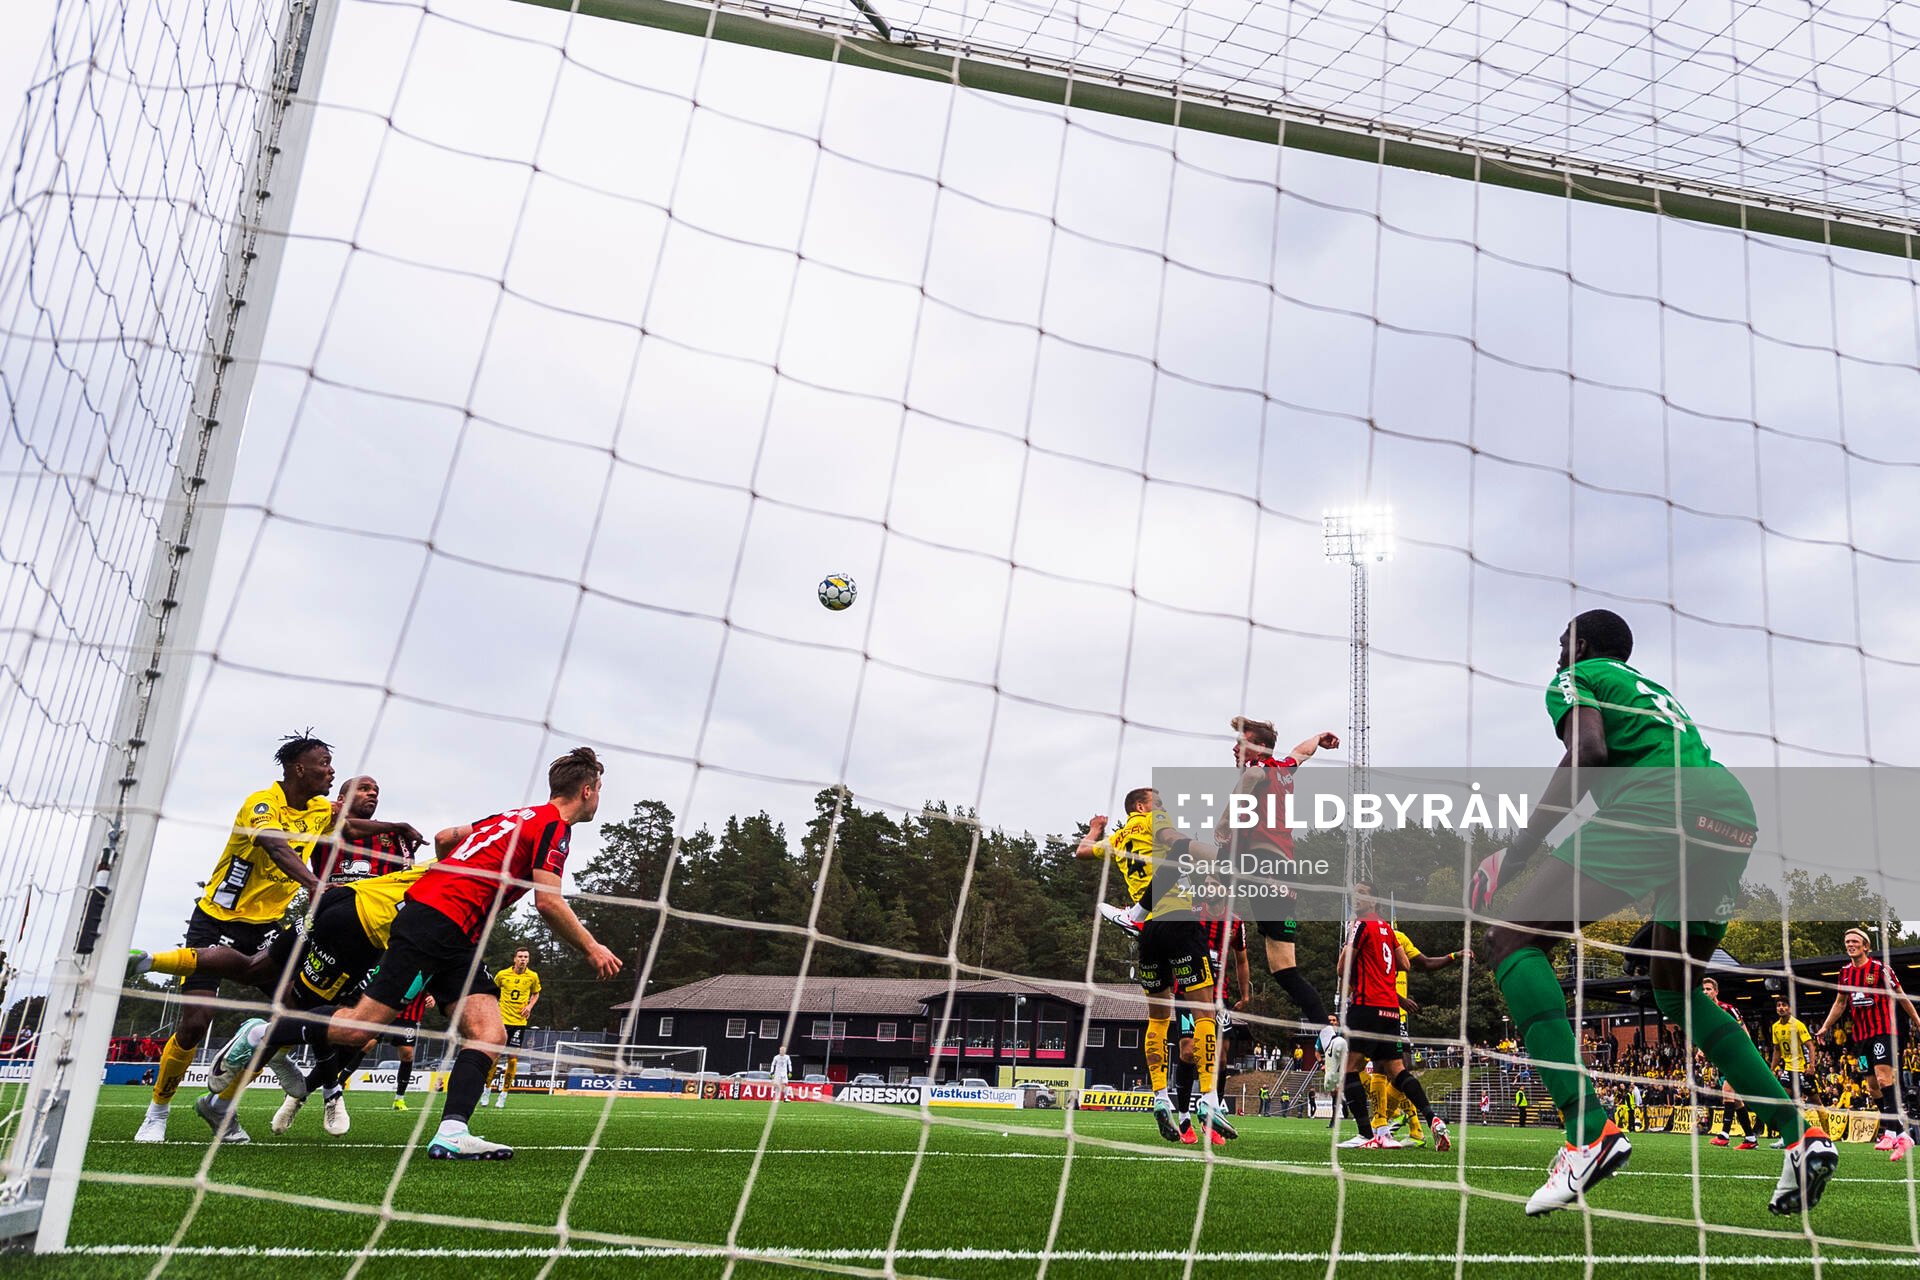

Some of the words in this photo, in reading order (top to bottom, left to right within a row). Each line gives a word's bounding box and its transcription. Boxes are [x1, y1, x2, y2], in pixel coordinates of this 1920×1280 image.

[1698, 816, 1754, 846] BAUHAUS
[1382, 942, 1392, 974] 9
[517, 1079, 534, 1088] TILL
[835, 1087, 920, 1104] ARBESKO
[930, 1087, 1017, 1102] VästkustStugan
[1083, 1091, 1155, 1106] BLÅKLÄDER
